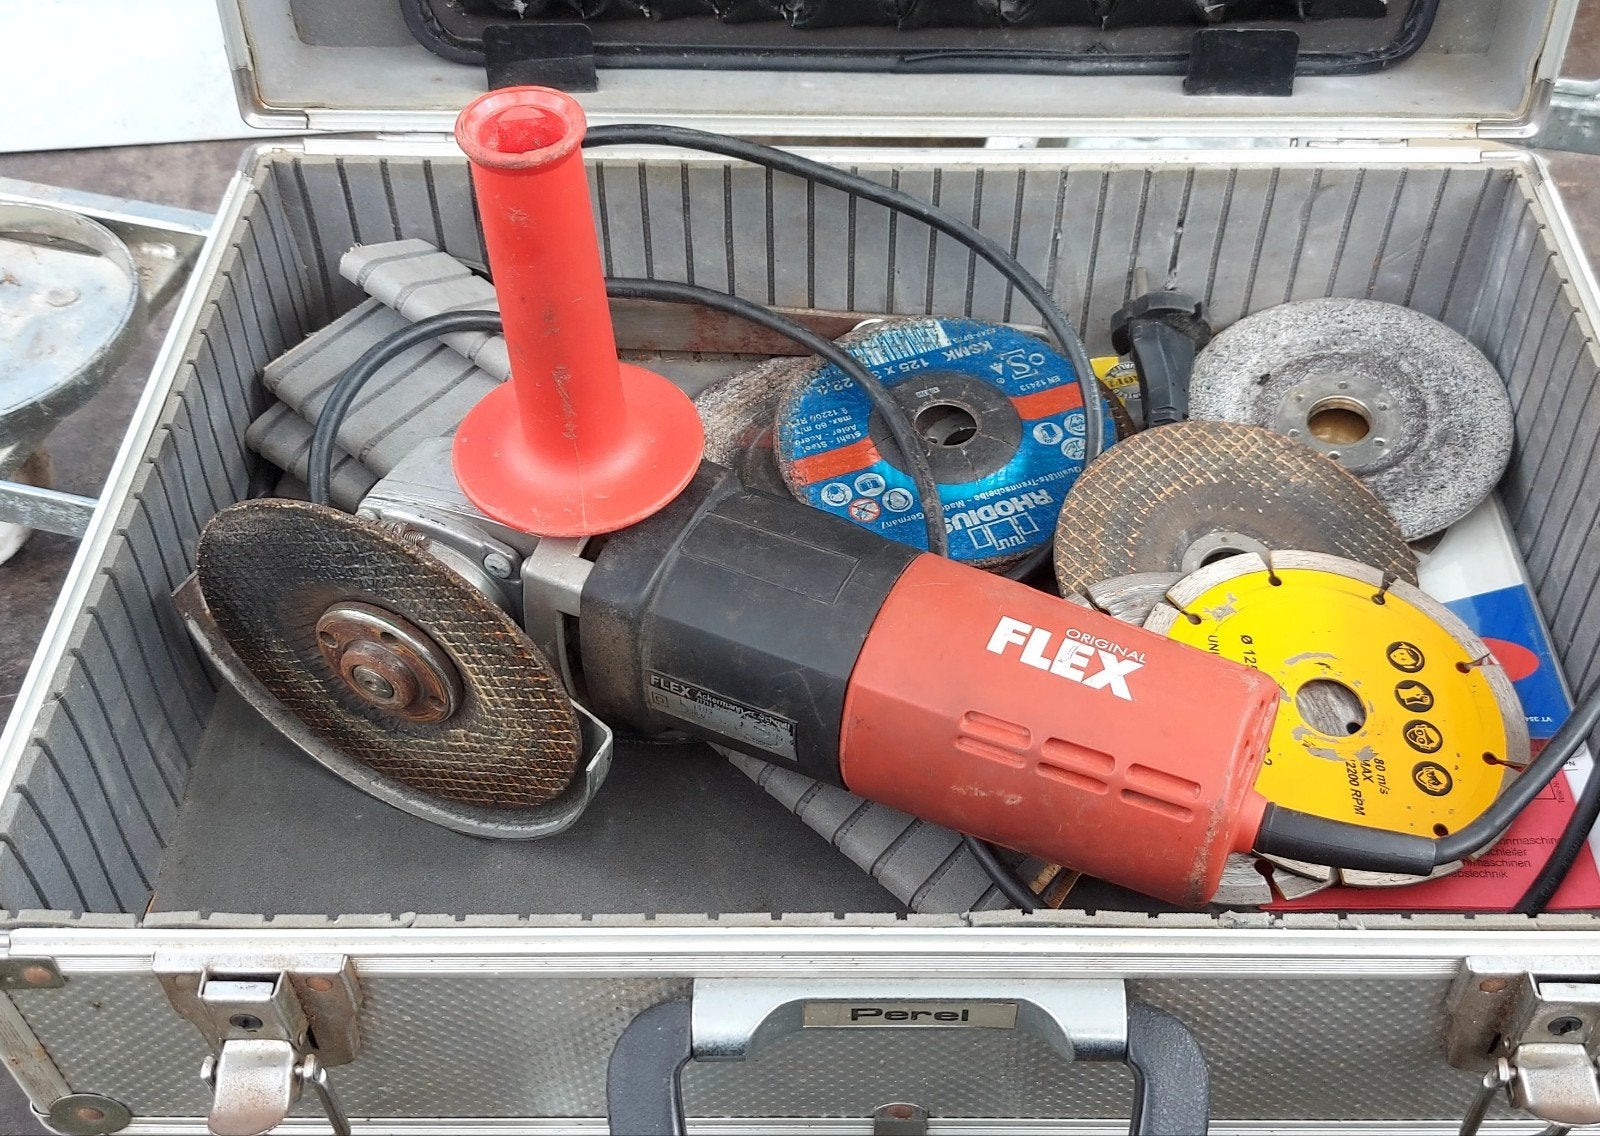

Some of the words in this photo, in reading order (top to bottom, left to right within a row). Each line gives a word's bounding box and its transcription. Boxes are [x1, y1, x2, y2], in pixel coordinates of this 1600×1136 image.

[941, 340, 993, 362] KSMK
[898, 357, 930, 373] 125
[1019, 378, 1047, 392] 12413
[1048, 373, 1061, 383] EN
[829, 414, 852, 426] max.
[836, 430, 862, 443] Stahl
[801, 440, 828, 453] Steel
[880, 512, 925, 531] Germany
[1065, 628, 1147, 664] ORIGINAL
[1208, 634, 1220, 655] UNI
[985, 615, 1144, 702] FLEX
[650, 674, 691, 698] FLEX
[696, 691, 744, 714] Ackermann
[1345, 760, 1360, 787] 2200
[1373, 757, 1386, 772] 80
[1376, 773, 1391, 795] m/s
[1350, 788, 1366, 816] RPM
[850, 1007, 969, 1022] Perel
